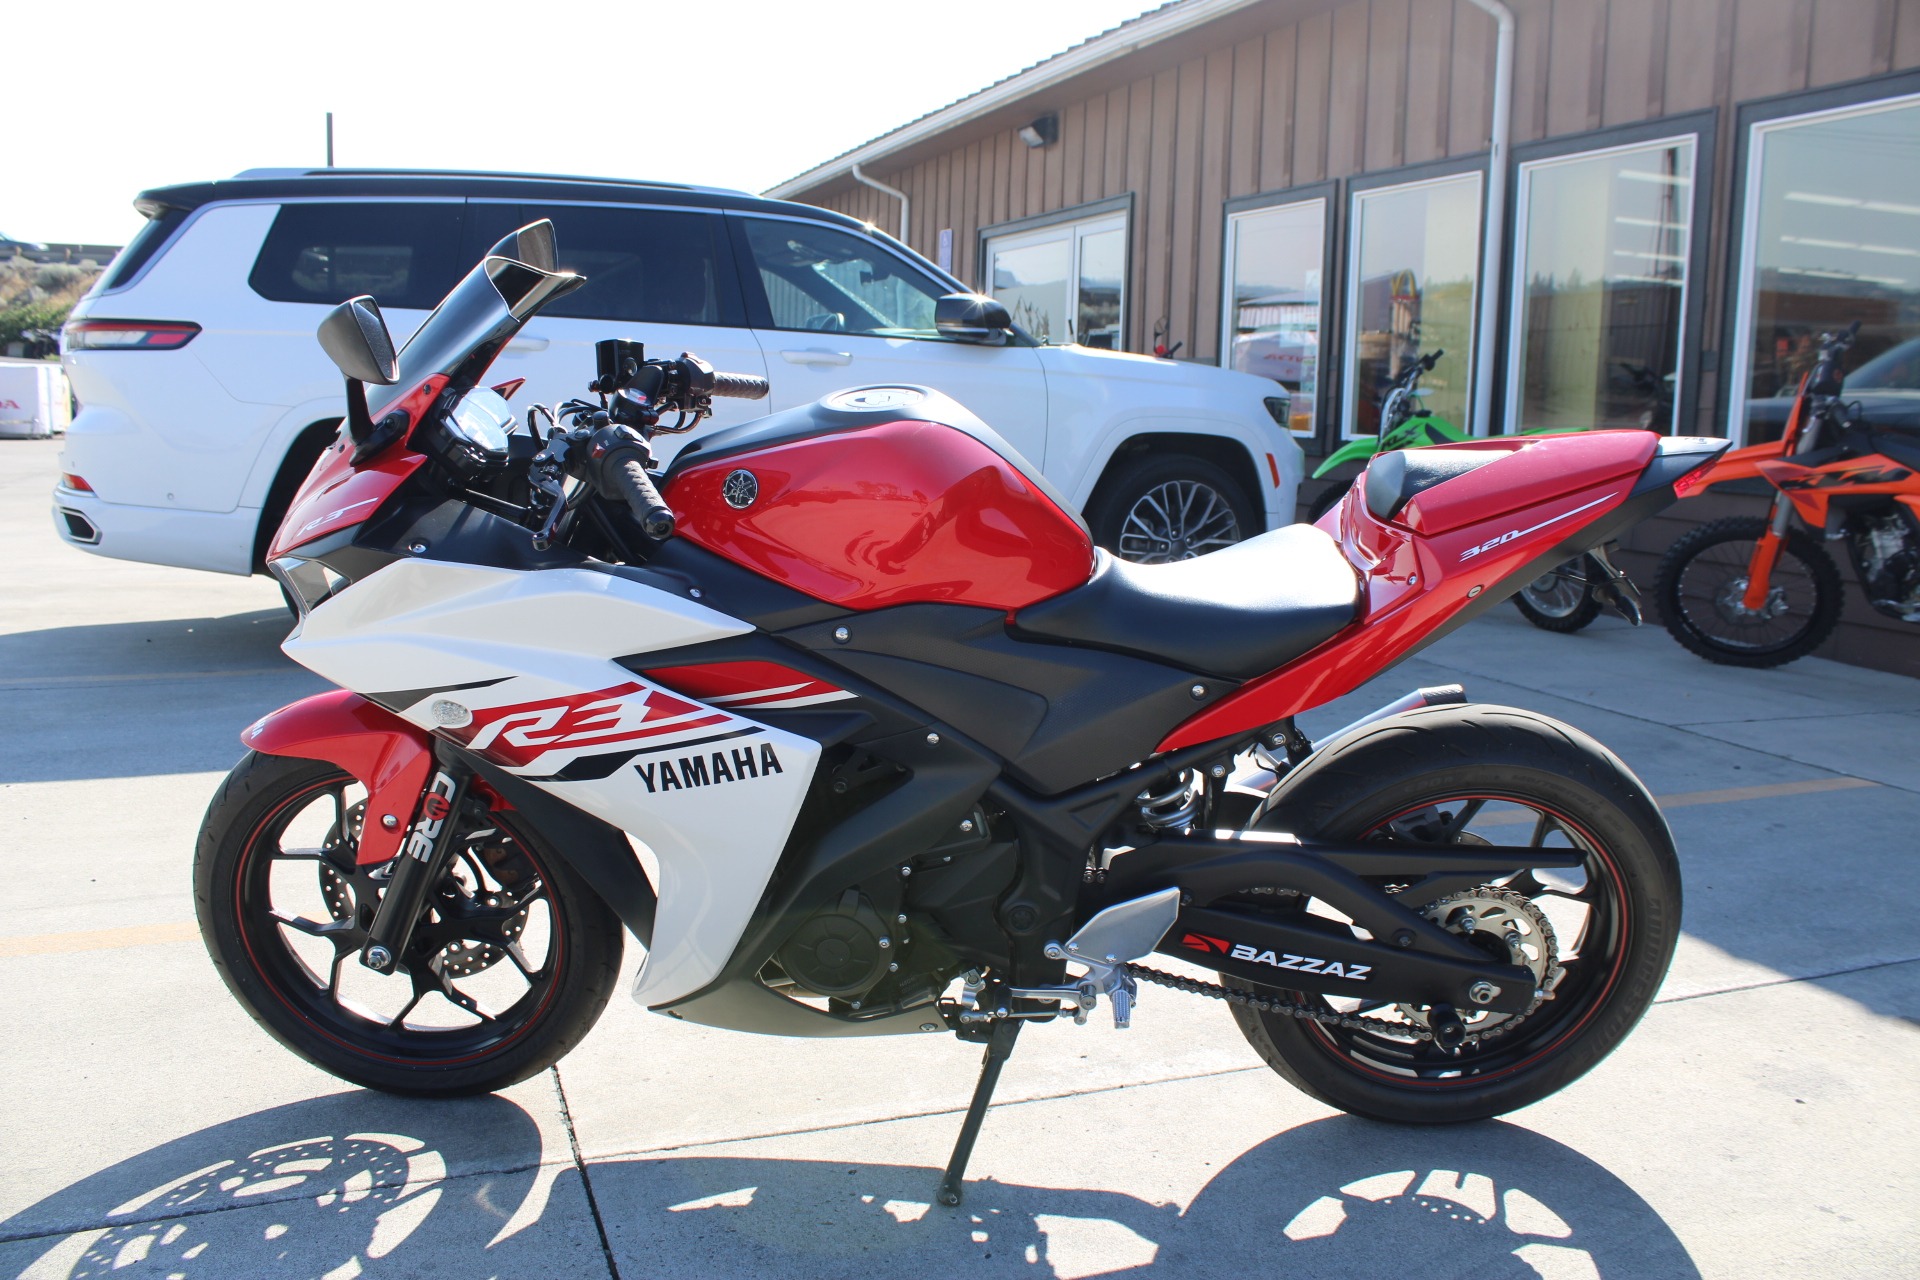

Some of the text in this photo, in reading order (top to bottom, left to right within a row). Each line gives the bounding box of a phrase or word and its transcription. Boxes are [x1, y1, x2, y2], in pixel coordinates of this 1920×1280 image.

[1459, 529, 1520, 563] 320
[464, 696, 652, 748] R3
[633, 742, 784, 793] YAMAHA
[1230, 943, 1372, 981] BAZZAZ
